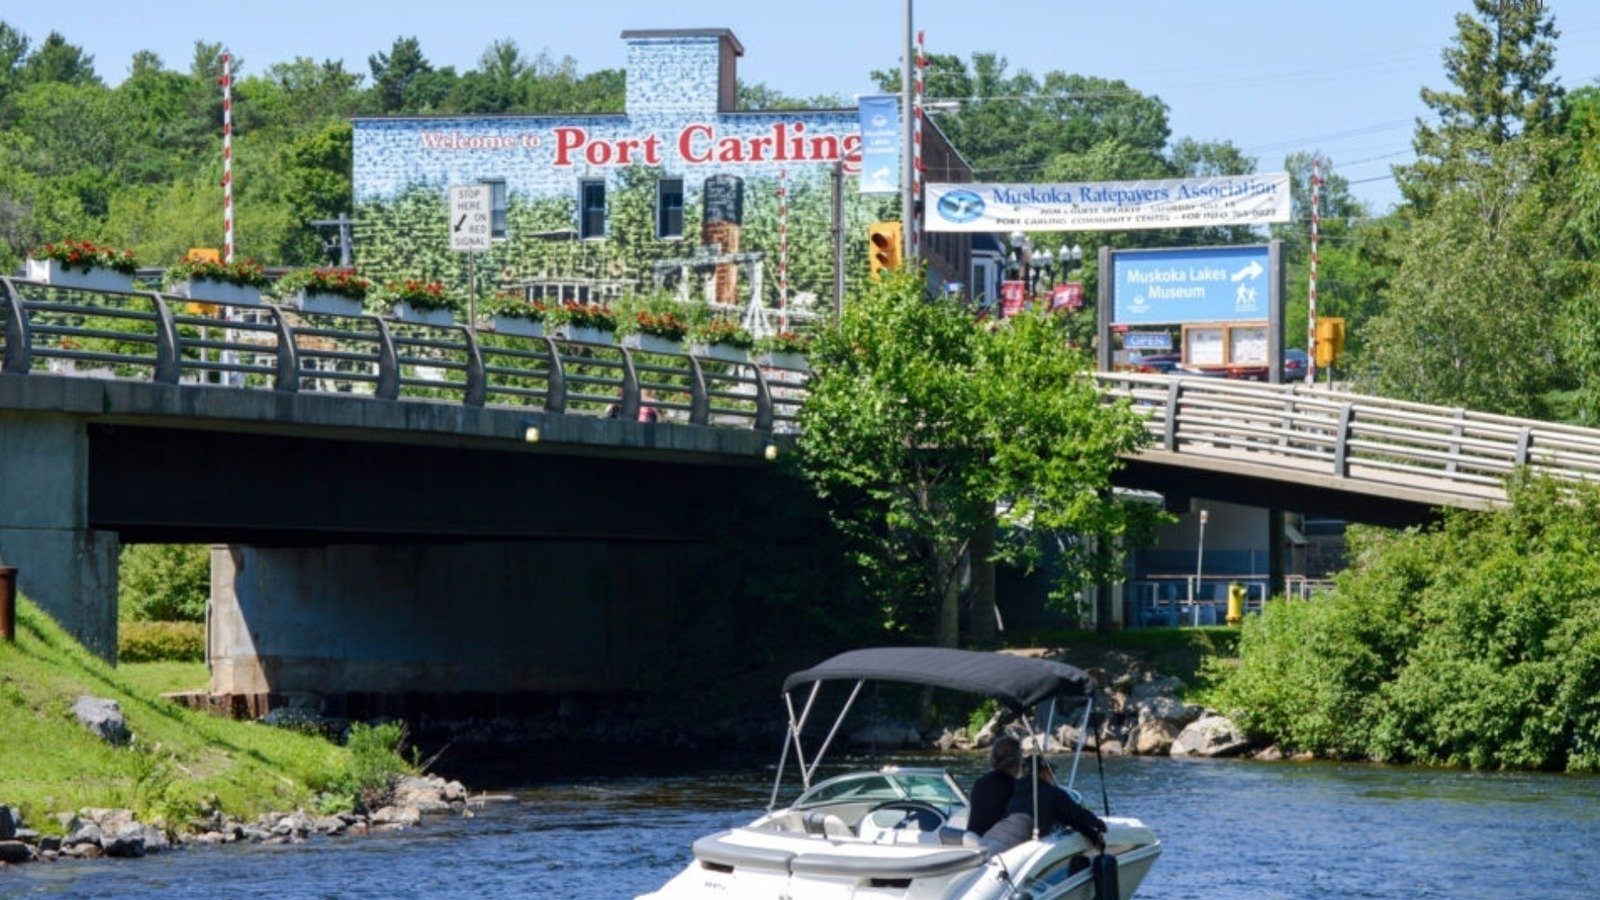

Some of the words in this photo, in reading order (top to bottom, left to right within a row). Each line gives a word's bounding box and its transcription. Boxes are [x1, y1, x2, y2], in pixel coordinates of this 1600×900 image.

[420, 132, 515, 149] Welcome
[521, 133, 542, 148] to
[553, 128, 661, 165] Port
[679, 122, 862, 173] Carling
[458, 190, 480, 199] STOP
[993, 186, 1072, 204] Muskoka
[1080, 185, 1169, 206] Ratepayers
[1178, 178, 1277, 199] Association
[458, 201, 480, 210] HERE
[474, 213, 487, 222] ON
[469, 224, 487, 234] RED
[455, 236, 485, 246] SIGNAL
[1127, 266, 1186, 283] Muskoka
[1190, 265, 1227, 281] Lakes
[1148, 285, 1205, 299] Museum
